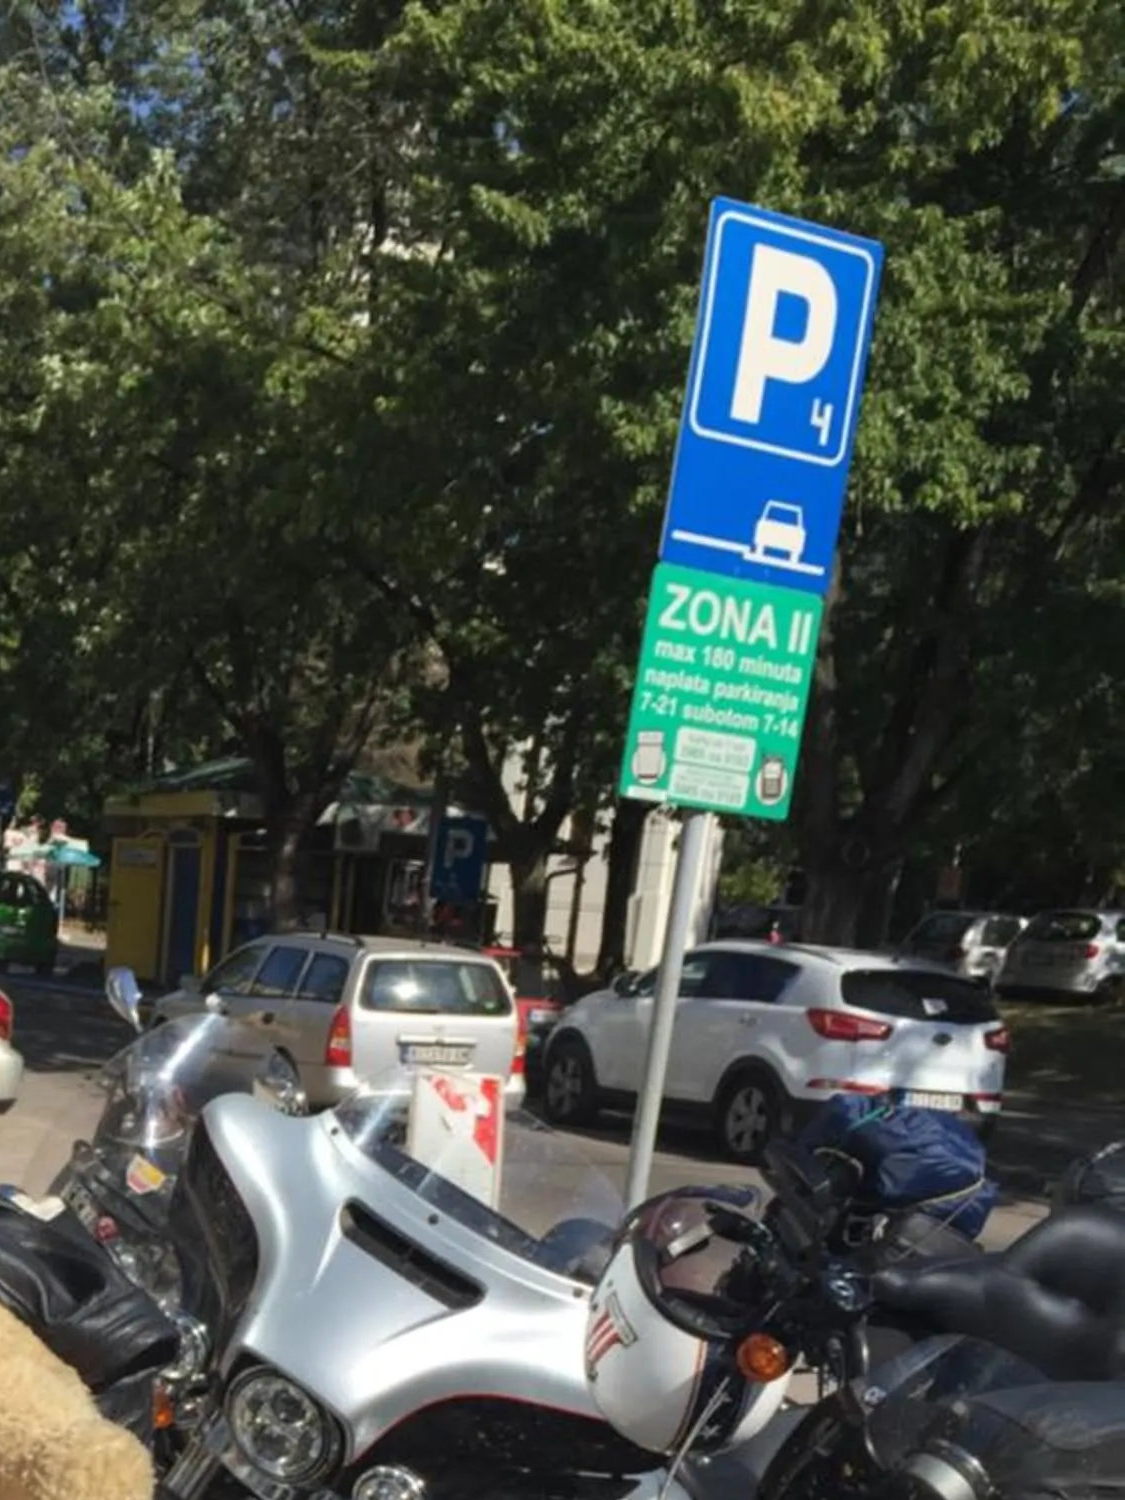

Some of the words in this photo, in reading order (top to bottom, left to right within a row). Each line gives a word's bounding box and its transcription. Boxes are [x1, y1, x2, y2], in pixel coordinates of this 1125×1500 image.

[730, 242, 838, 425] P
[809, 397, 834, 447] 4
[658, 582, 778, 650] ZONA
[787, 609, 814, 656] II
[655, 640, 697, 664] max
[702, 644, 736, 671] 180
[738, 653, 803, 685] minuta
[640, 691, 677, 717] 7-21
[682, 702, 760, 731] subotom
[762, 713, 799, 739] 7-14
[644, 668, 711, 695] naplata
[712, 680, 800, 714] parkiranja
[443, 829, 475, 870] P
